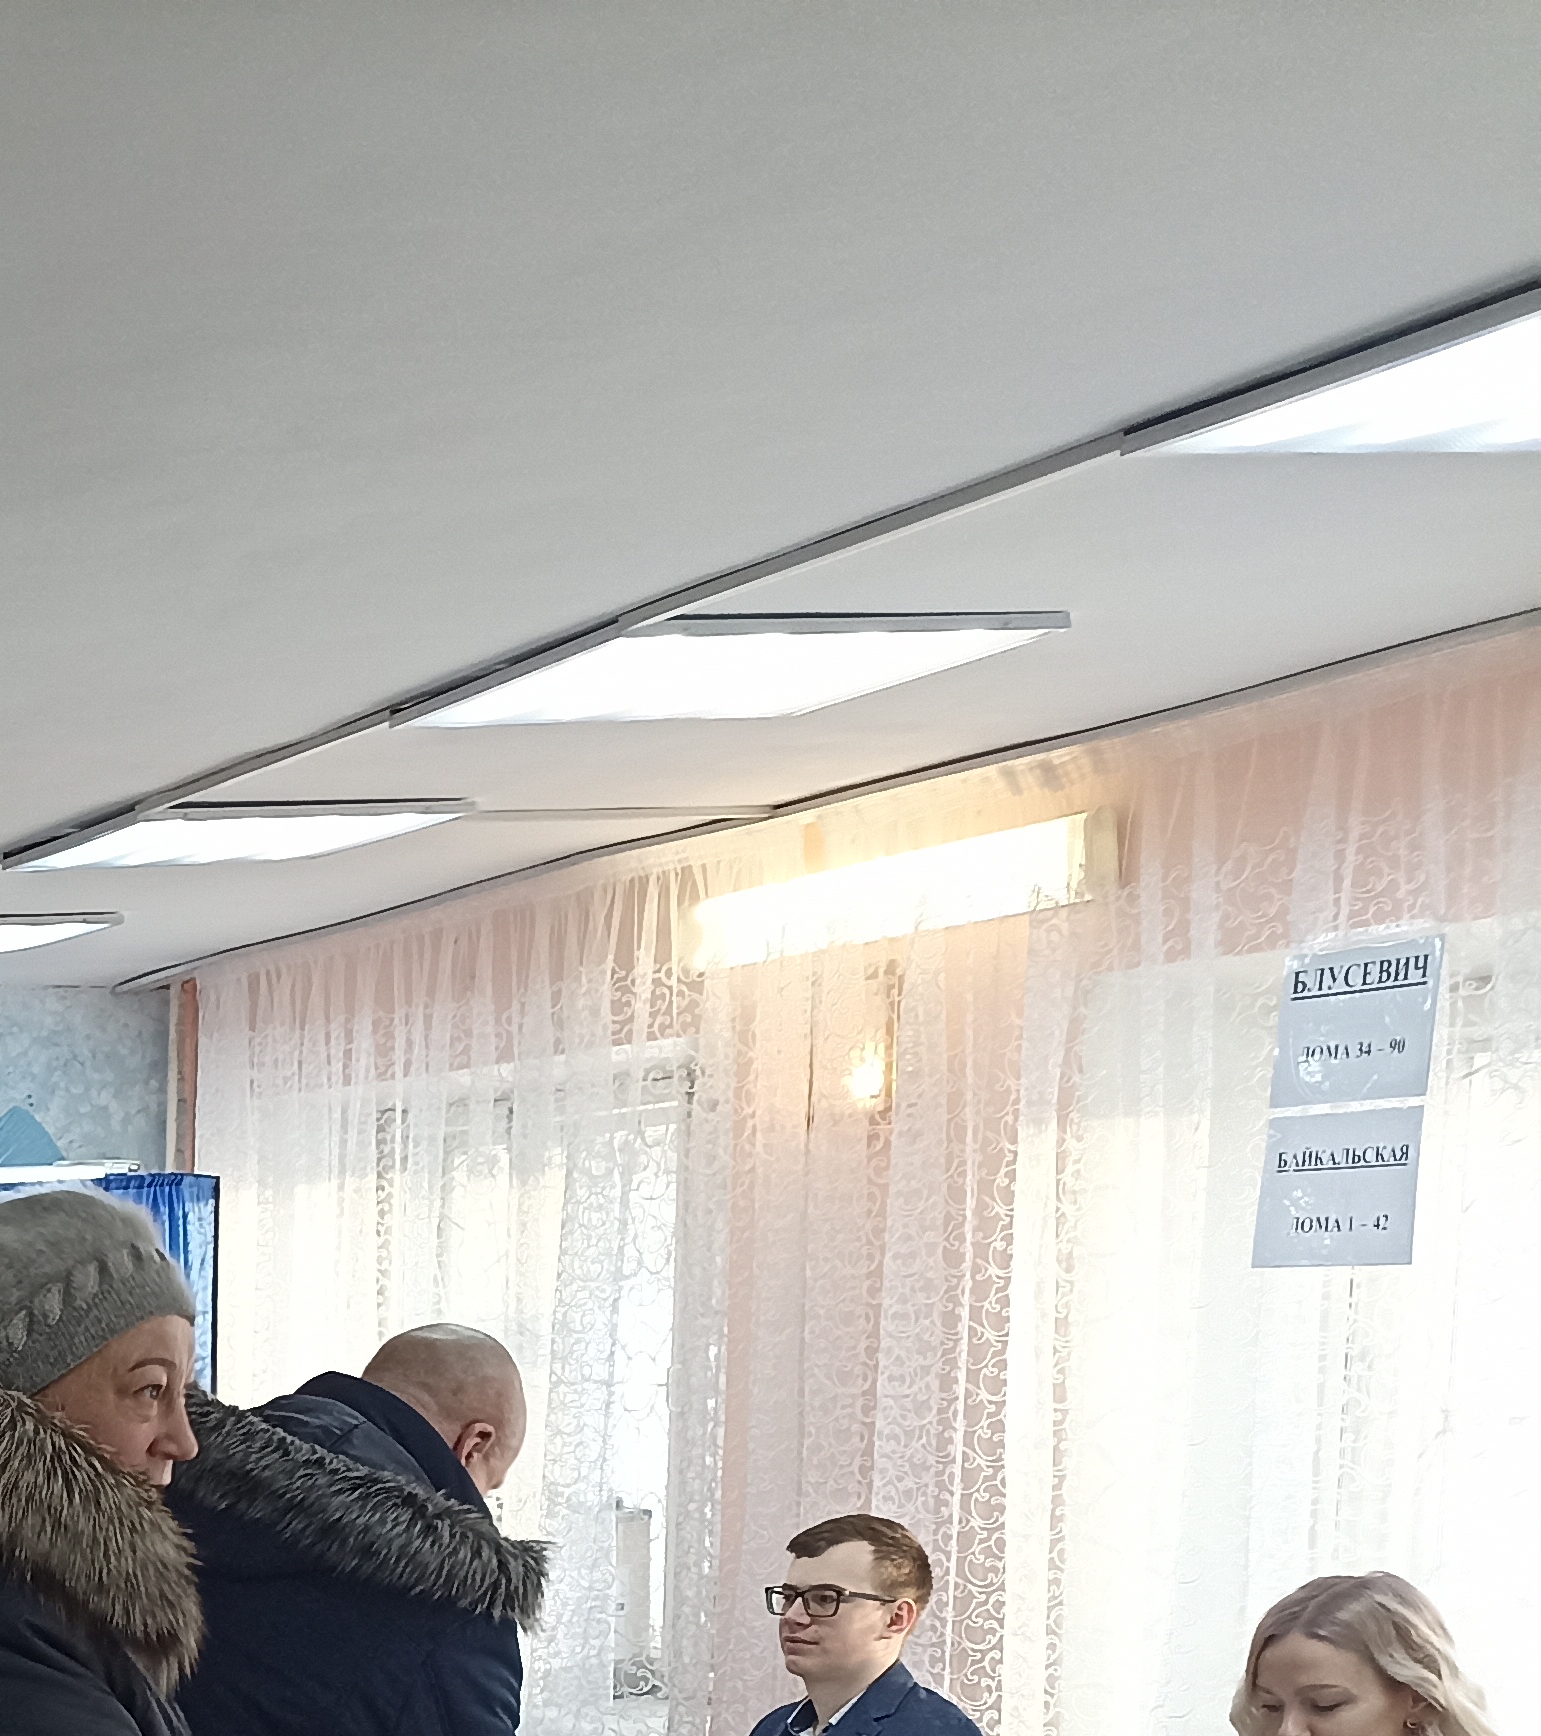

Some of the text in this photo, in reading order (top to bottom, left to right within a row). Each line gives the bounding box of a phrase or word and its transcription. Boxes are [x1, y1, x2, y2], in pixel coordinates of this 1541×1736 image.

[1291, 953, 1429, 989] БЛУСЕВИЧ
[1355, 1040, 1373, 1059] 34
[1388, 1037, 1406, 1055] 90
[1278, 1144, 1409, 1168] БАЙКАЛЬСКАЯ
[1348, 1216, 1354, 1233] 1
[1373, 1213, 1389, 1232] 42
